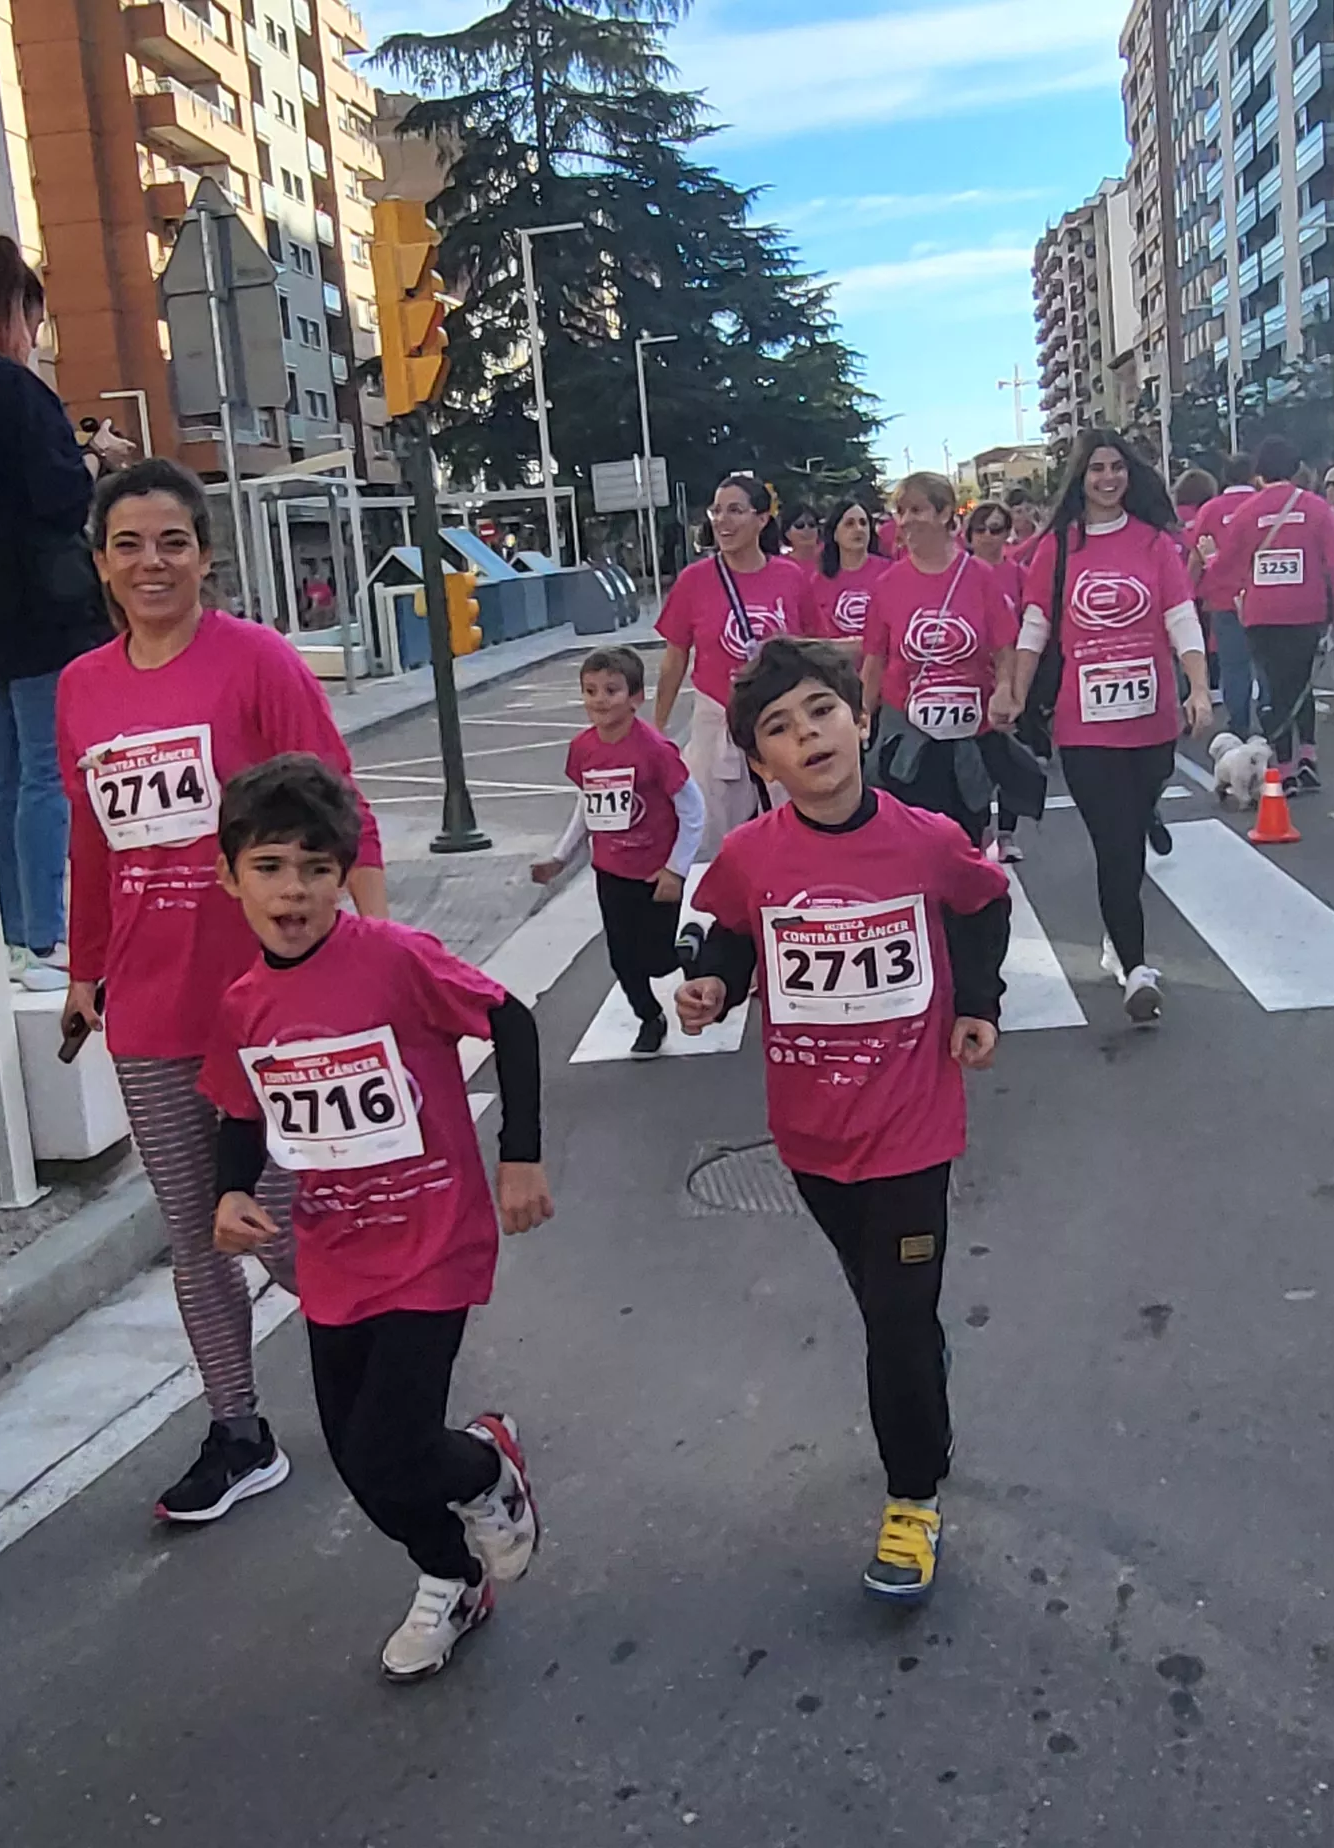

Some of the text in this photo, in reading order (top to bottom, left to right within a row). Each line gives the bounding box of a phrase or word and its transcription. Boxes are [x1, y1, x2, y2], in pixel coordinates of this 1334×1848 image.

[1259, 561, 1299, 575] 3253
[1090, 680, 1150, 706] 1715
[918, 706, 976, 726] 1716
[100, 765, 205, 820] 2714
[782, 920, 910, 944] CONTRA EL CÁNCER
[782, 939, 915, 992] 2713
[325, 1056, 381, 1077] CÁNCER
[269, 1076, 395, 1134] 2716
